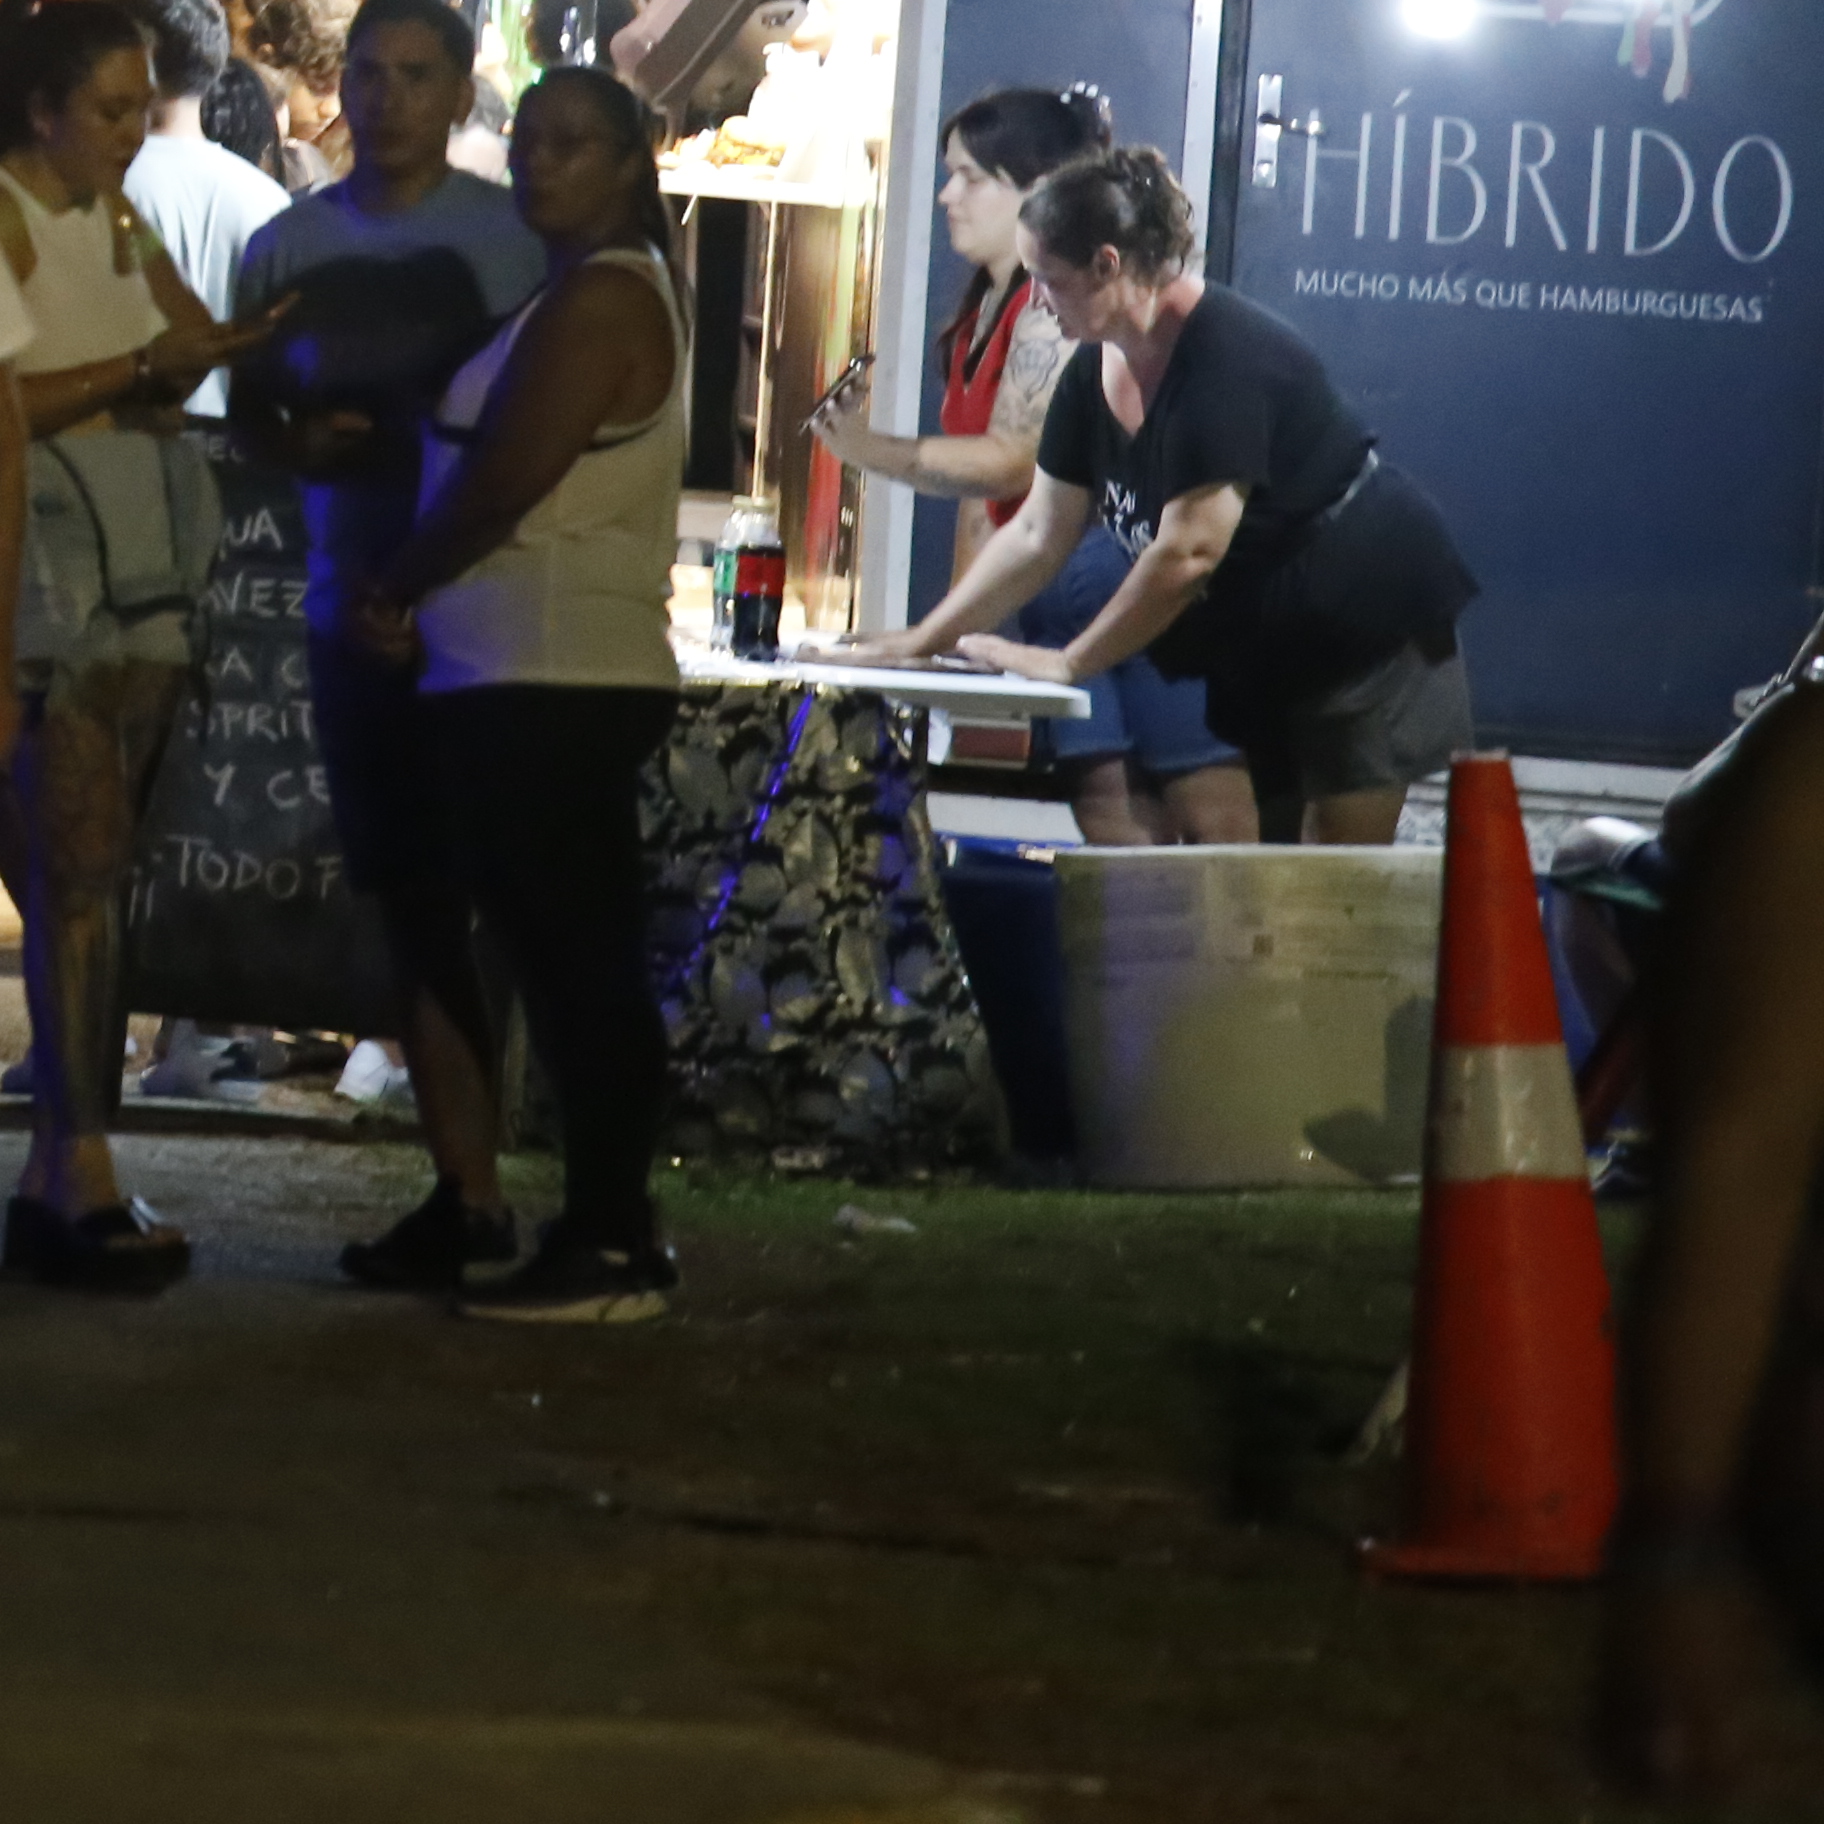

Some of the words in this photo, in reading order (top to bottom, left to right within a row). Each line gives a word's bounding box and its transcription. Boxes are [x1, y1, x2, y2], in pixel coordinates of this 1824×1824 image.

[1302, 88, 1793, 263] HÍBRIDO
[1294, 269, 1400, 299] MUCHO
[1407, 271, 1467, 304] MÁS
[1475, 278, 1531, 309] QUE
[1539, 283, 1764, 324] HAMBURGUESAS
[219, 507, 283, 560] UA
[203, 761, 237, 807] Y
